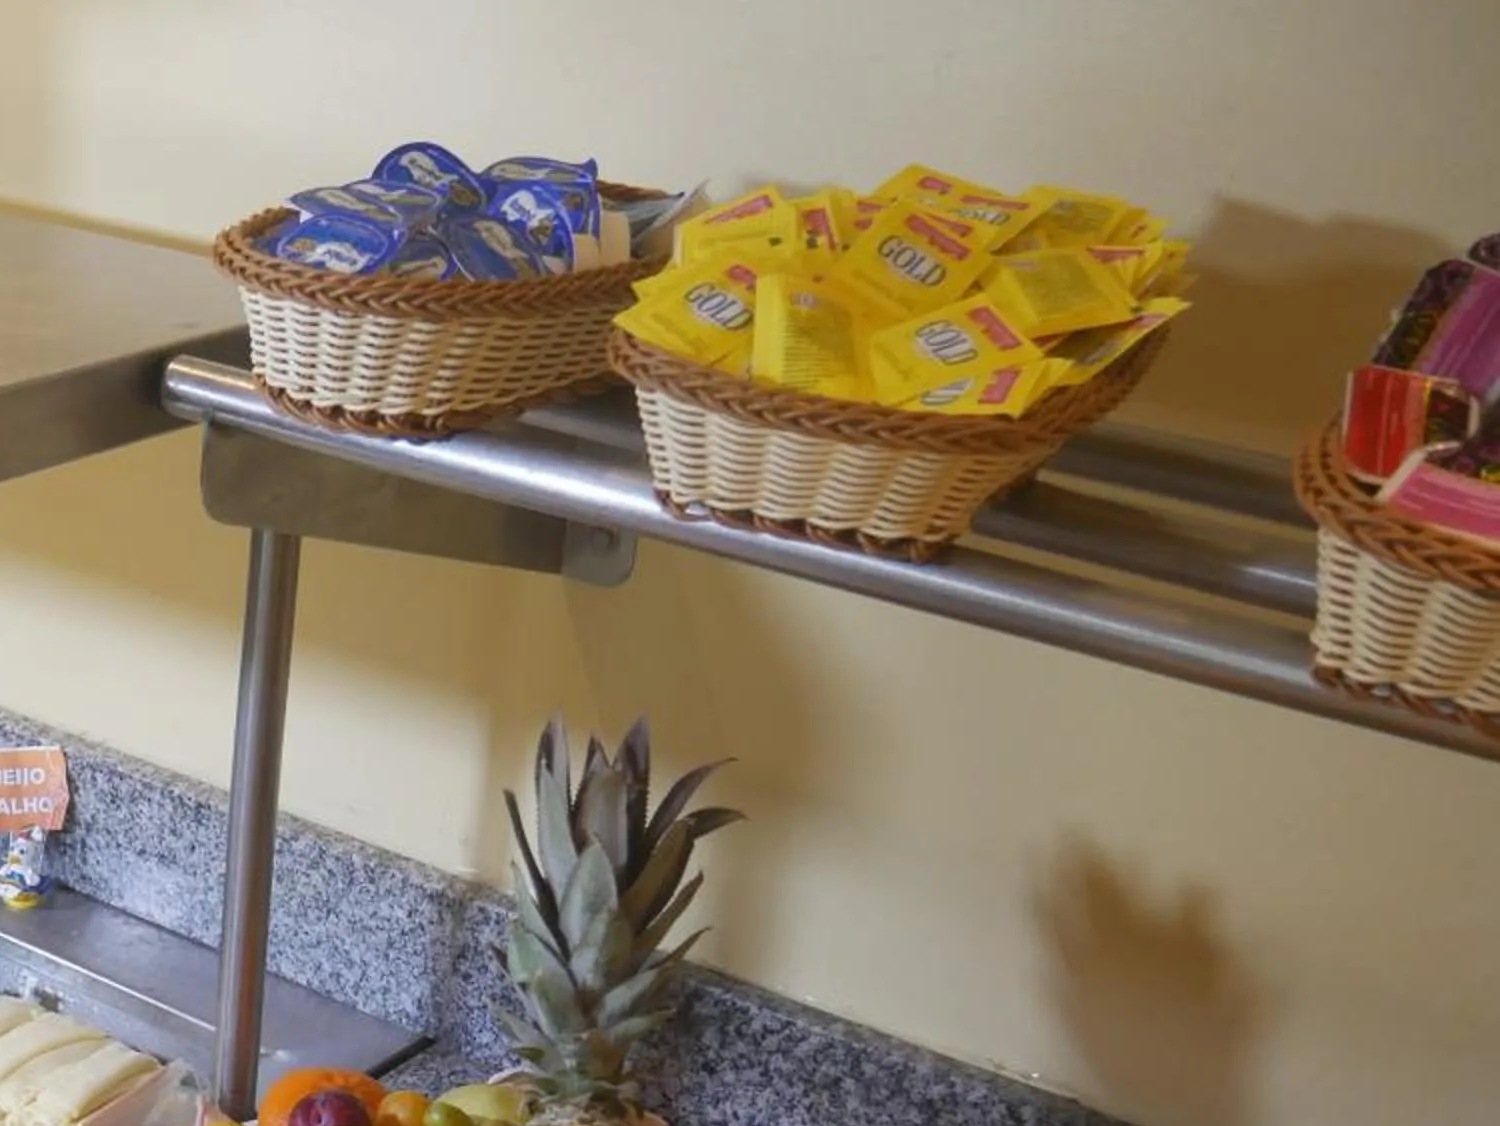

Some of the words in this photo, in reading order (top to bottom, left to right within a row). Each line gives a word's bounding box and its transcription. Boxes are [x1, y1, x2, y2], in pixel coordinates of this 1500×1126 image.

[878, 234, 946, 287] GOLD
[684, 282, 754, 331] GOLD
[915, 319, 978, 366] GOLD
